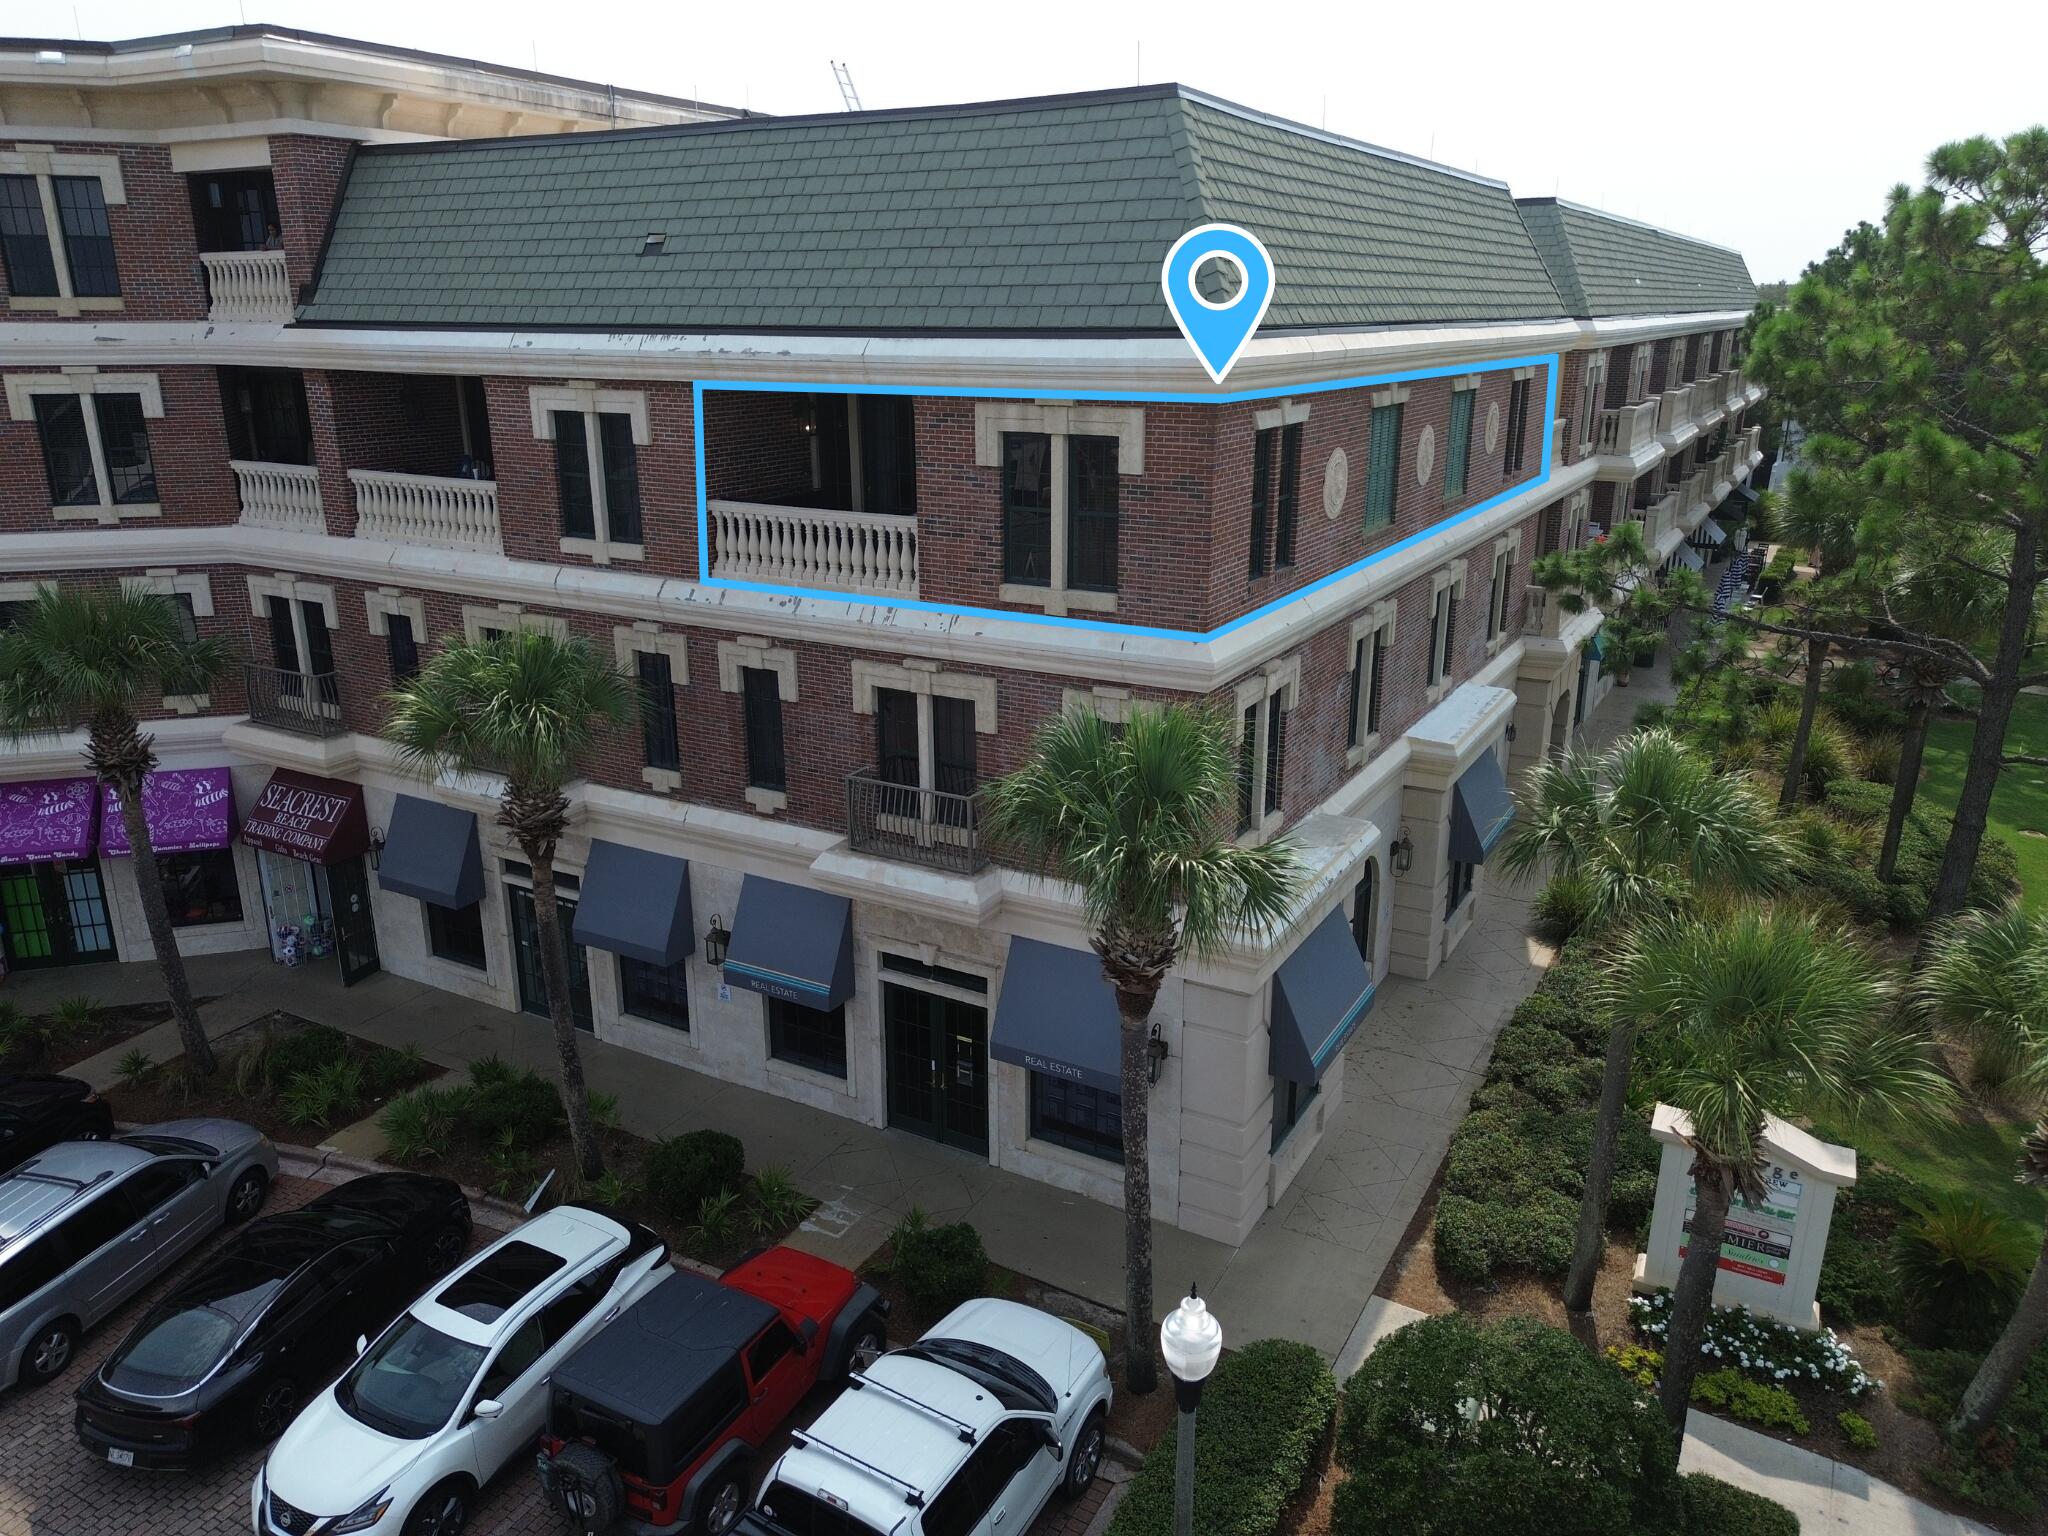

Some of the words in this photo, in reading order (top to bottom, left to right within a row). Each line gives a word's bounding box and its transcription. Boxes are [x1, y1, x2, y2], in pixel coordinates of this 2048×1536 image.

[260, 784, 346, 822] SEACREST
[273, 811, 312, 831] BEACH
[244, 820, 284, 840] TRADING
[282, 830, 327, 851] COMPANY
[53, 850, 79, 859] Candy
[752, 980, 769, 992] REAL
[771, 985, 798, 999] ESTATE
[1025, 1055, 1048, 1069] REAL
[1050, 1062, 1083, 1079] ESTATE
[1727, 1234, 1765, 1252] MIER
